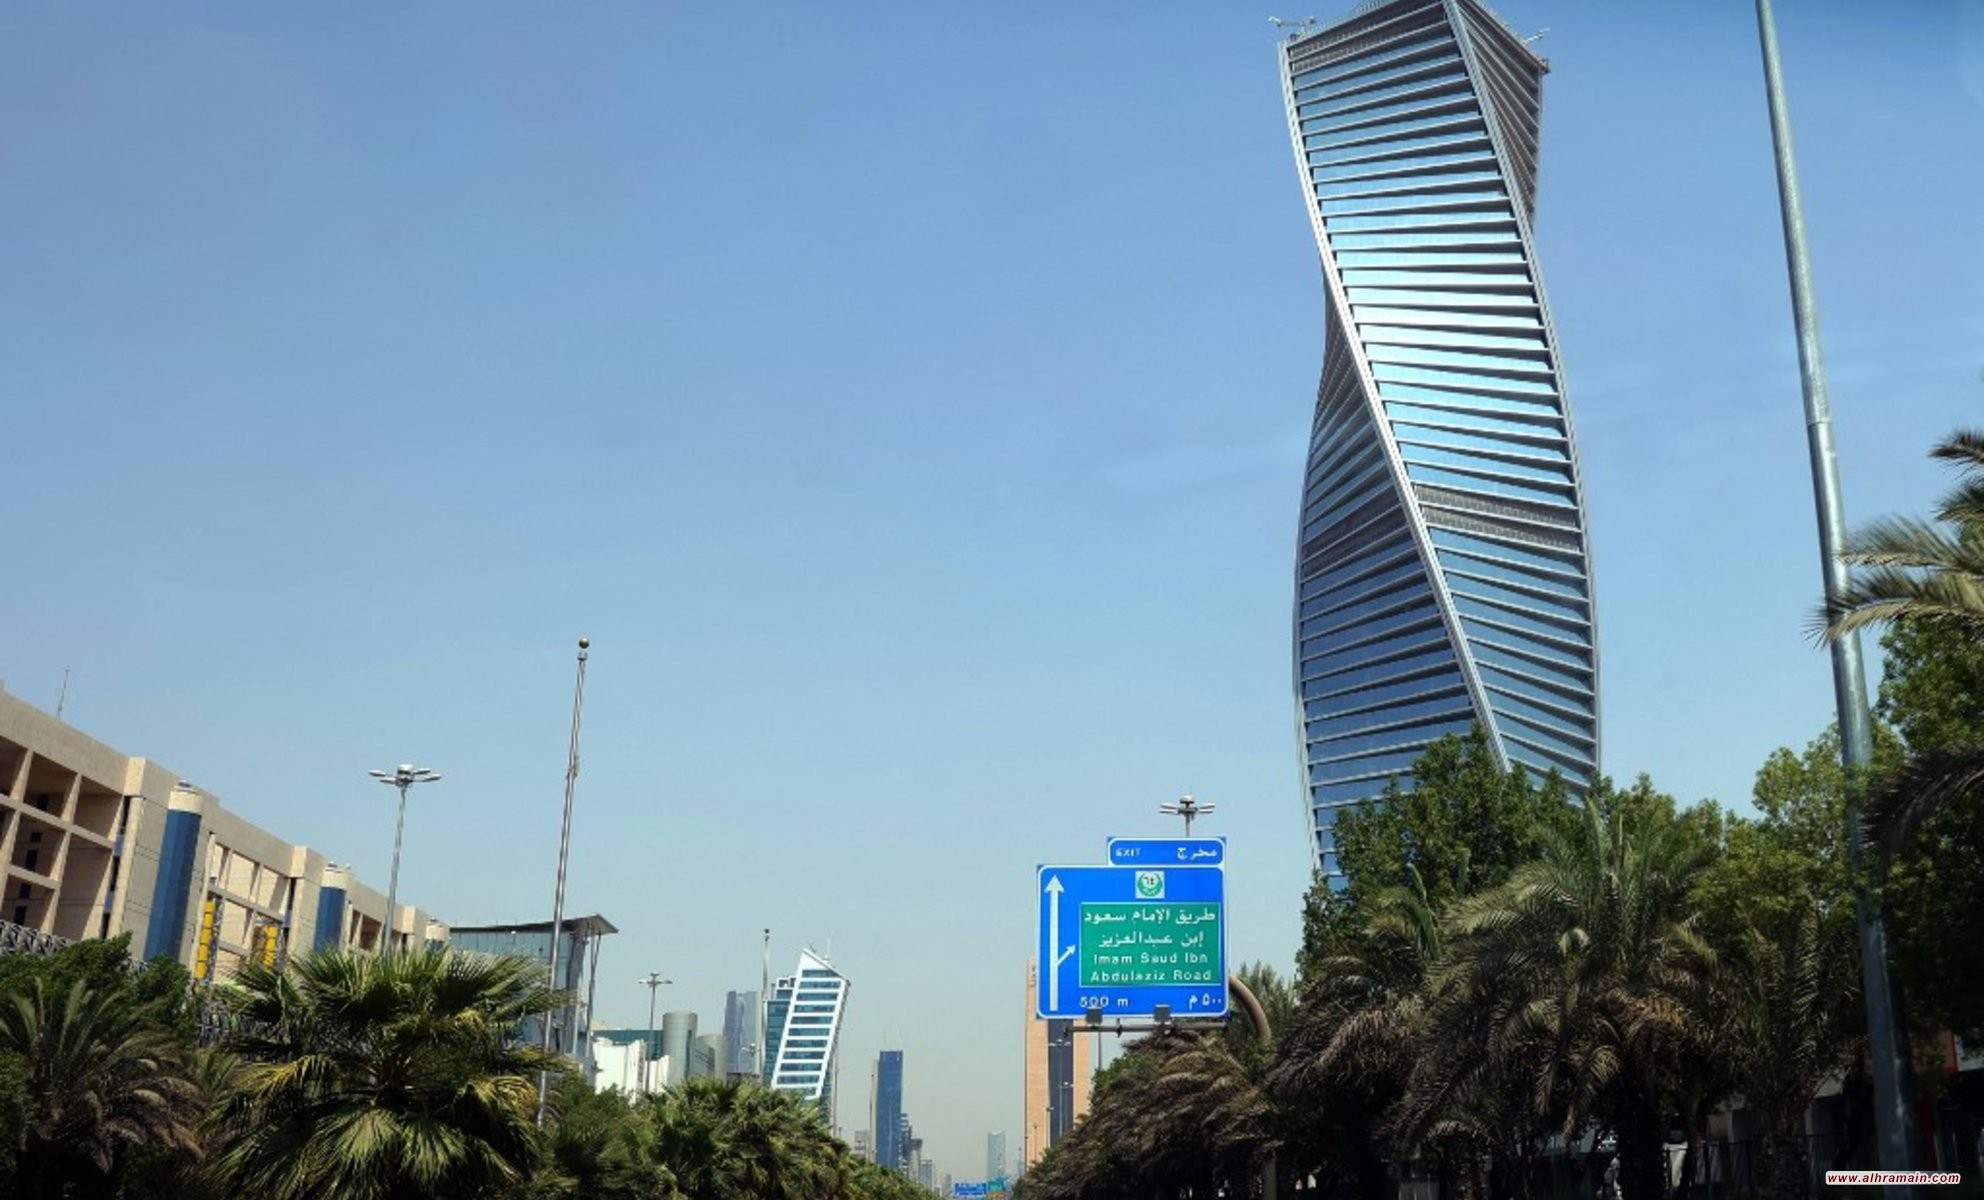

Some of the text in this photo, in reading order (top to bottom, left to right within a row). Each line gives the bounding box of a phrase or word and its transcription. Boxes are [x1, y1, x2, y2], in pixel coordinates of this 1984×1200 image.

[1115, 847, 1141, 857] EXIT
[1177, 847, 1217, 861] مخرج
[1084, 907, 1216, 925] طريق الإمام سعود
[1093, 952, 1208, 965] Imam Saud Ibn
[1090, 969, 1212, 982] Abdulaziz Road
[1079, 996, 1129, 1008] 500 m
